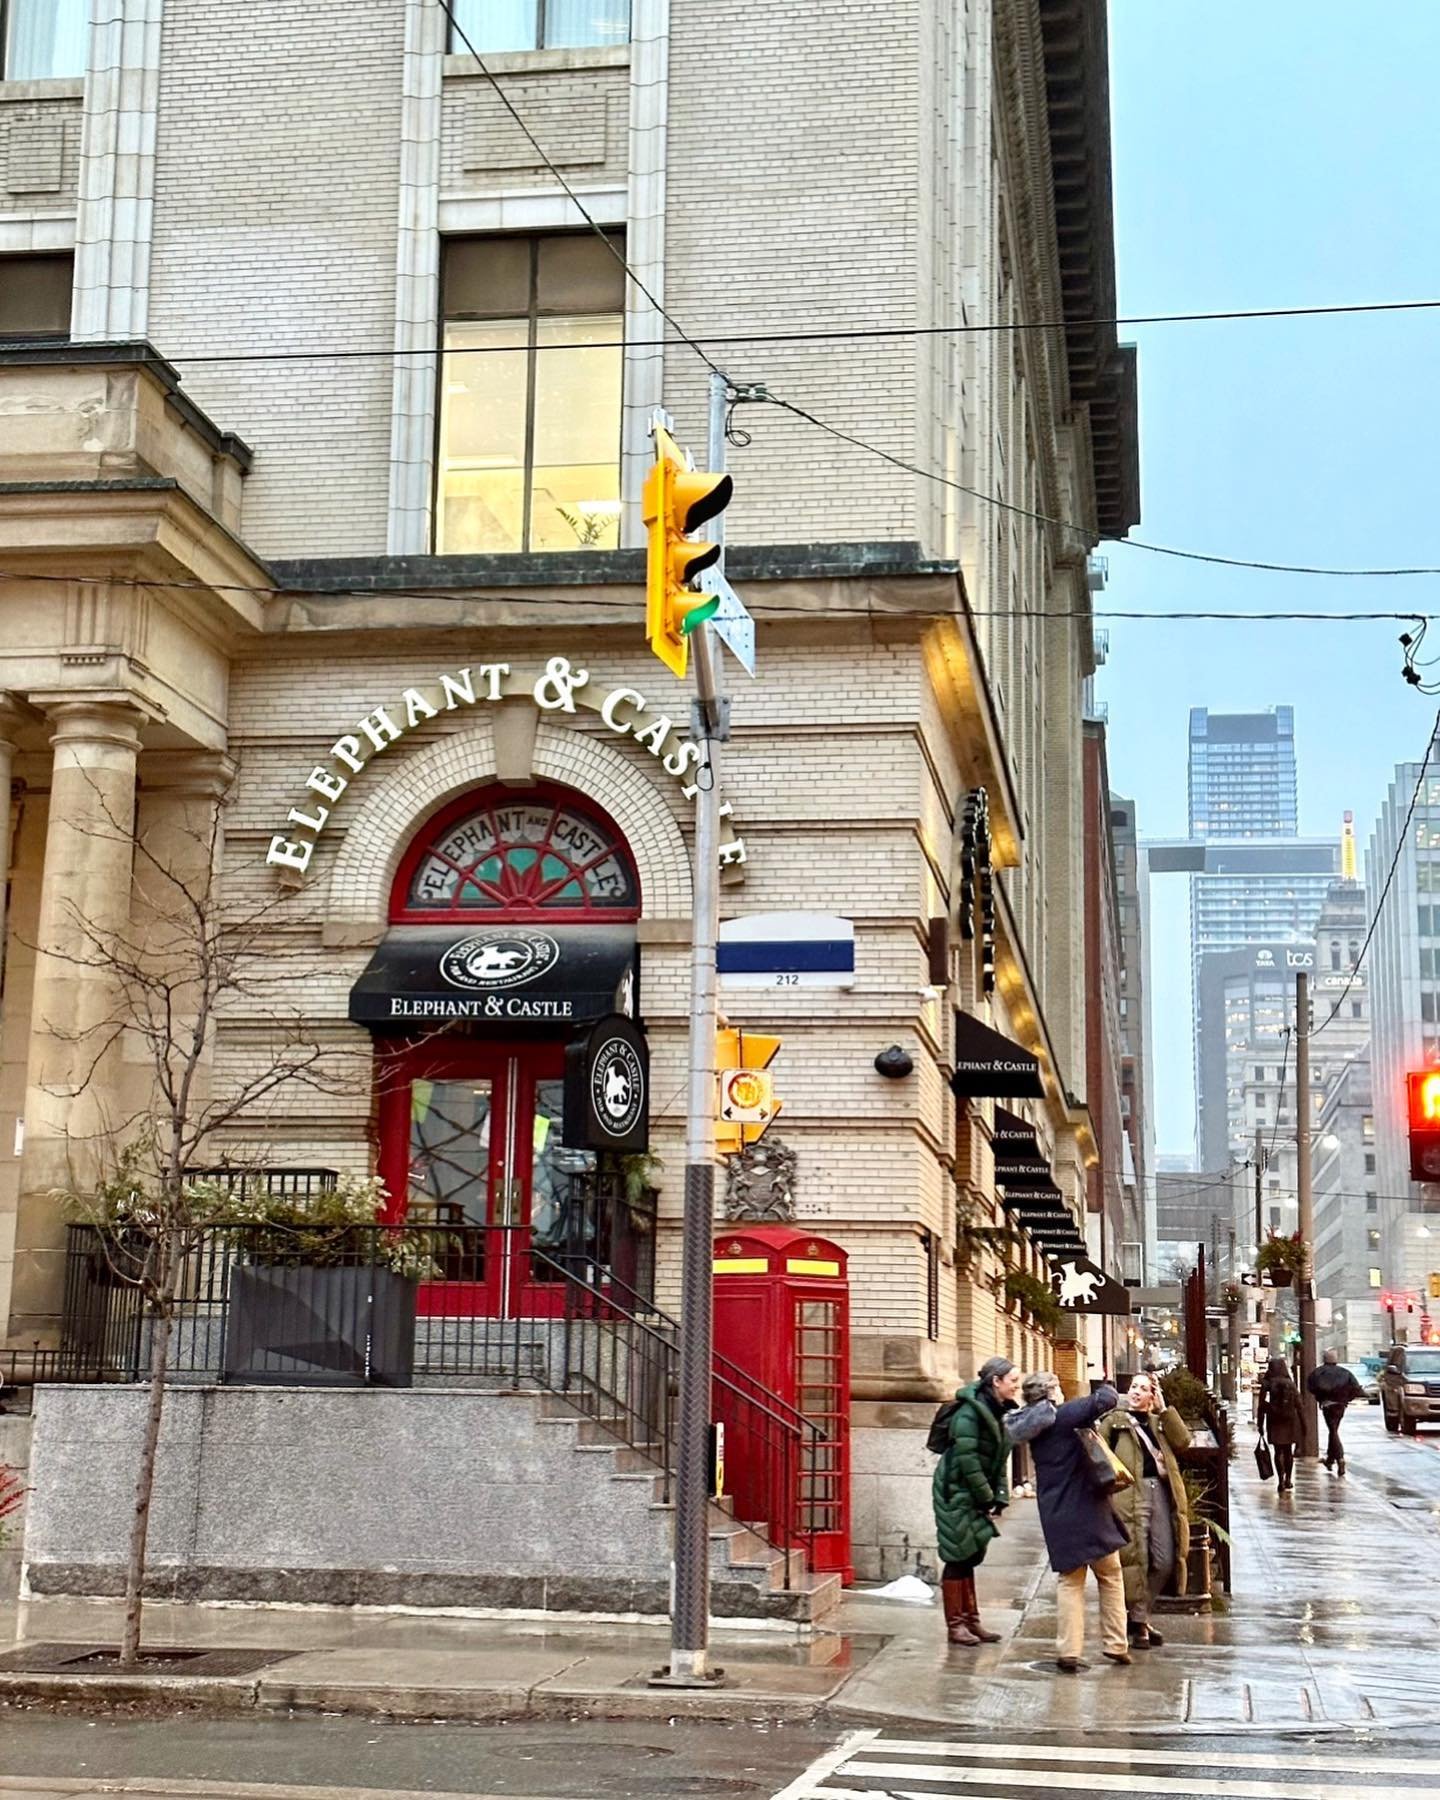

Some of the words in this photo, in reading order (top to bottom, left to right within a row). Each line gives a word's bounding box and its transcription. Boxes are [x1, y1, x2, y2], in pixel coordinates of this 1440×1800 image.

[265, 663, 511, 874] ELEPHANT
[532, 656, 590, 714] &
[424, 810, 526, 892] ELEPHANT
[554, 819, 619, 891] CASTLE
[776, 974, 800, 986] 212
[390, 997, 482, 1016] ELEPHANT
[484, 994, 503, 1016] &
[506, 997, 573, 1017] CASTLE
[956, 1061, 992, 1071] EPHANT
[992, 1059, 1004, 1071] &
[1003, 1061, 1037, 1072] CASTLE
